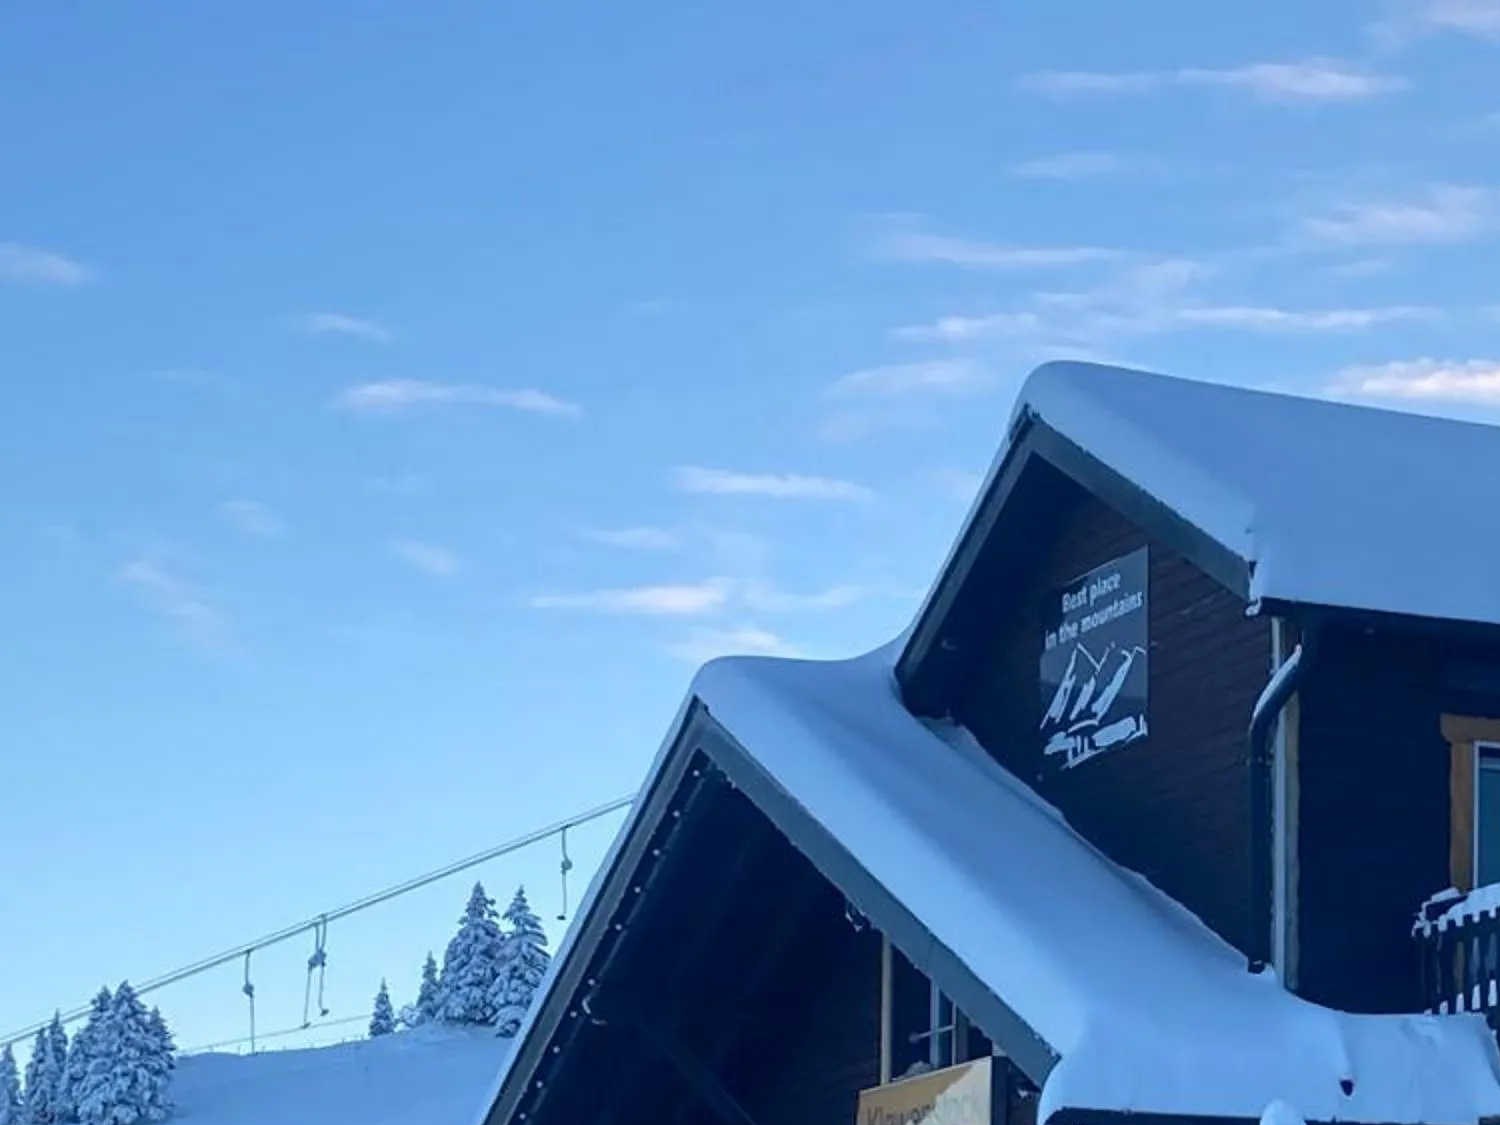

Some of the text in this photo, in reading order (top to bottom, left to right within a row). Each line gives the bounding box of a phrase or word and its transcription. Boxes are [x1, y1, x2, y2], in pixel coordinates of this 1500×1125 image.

[1062, 573, 1122, 614] Best place
[1045, 591, 1144, 651] in the mountains
